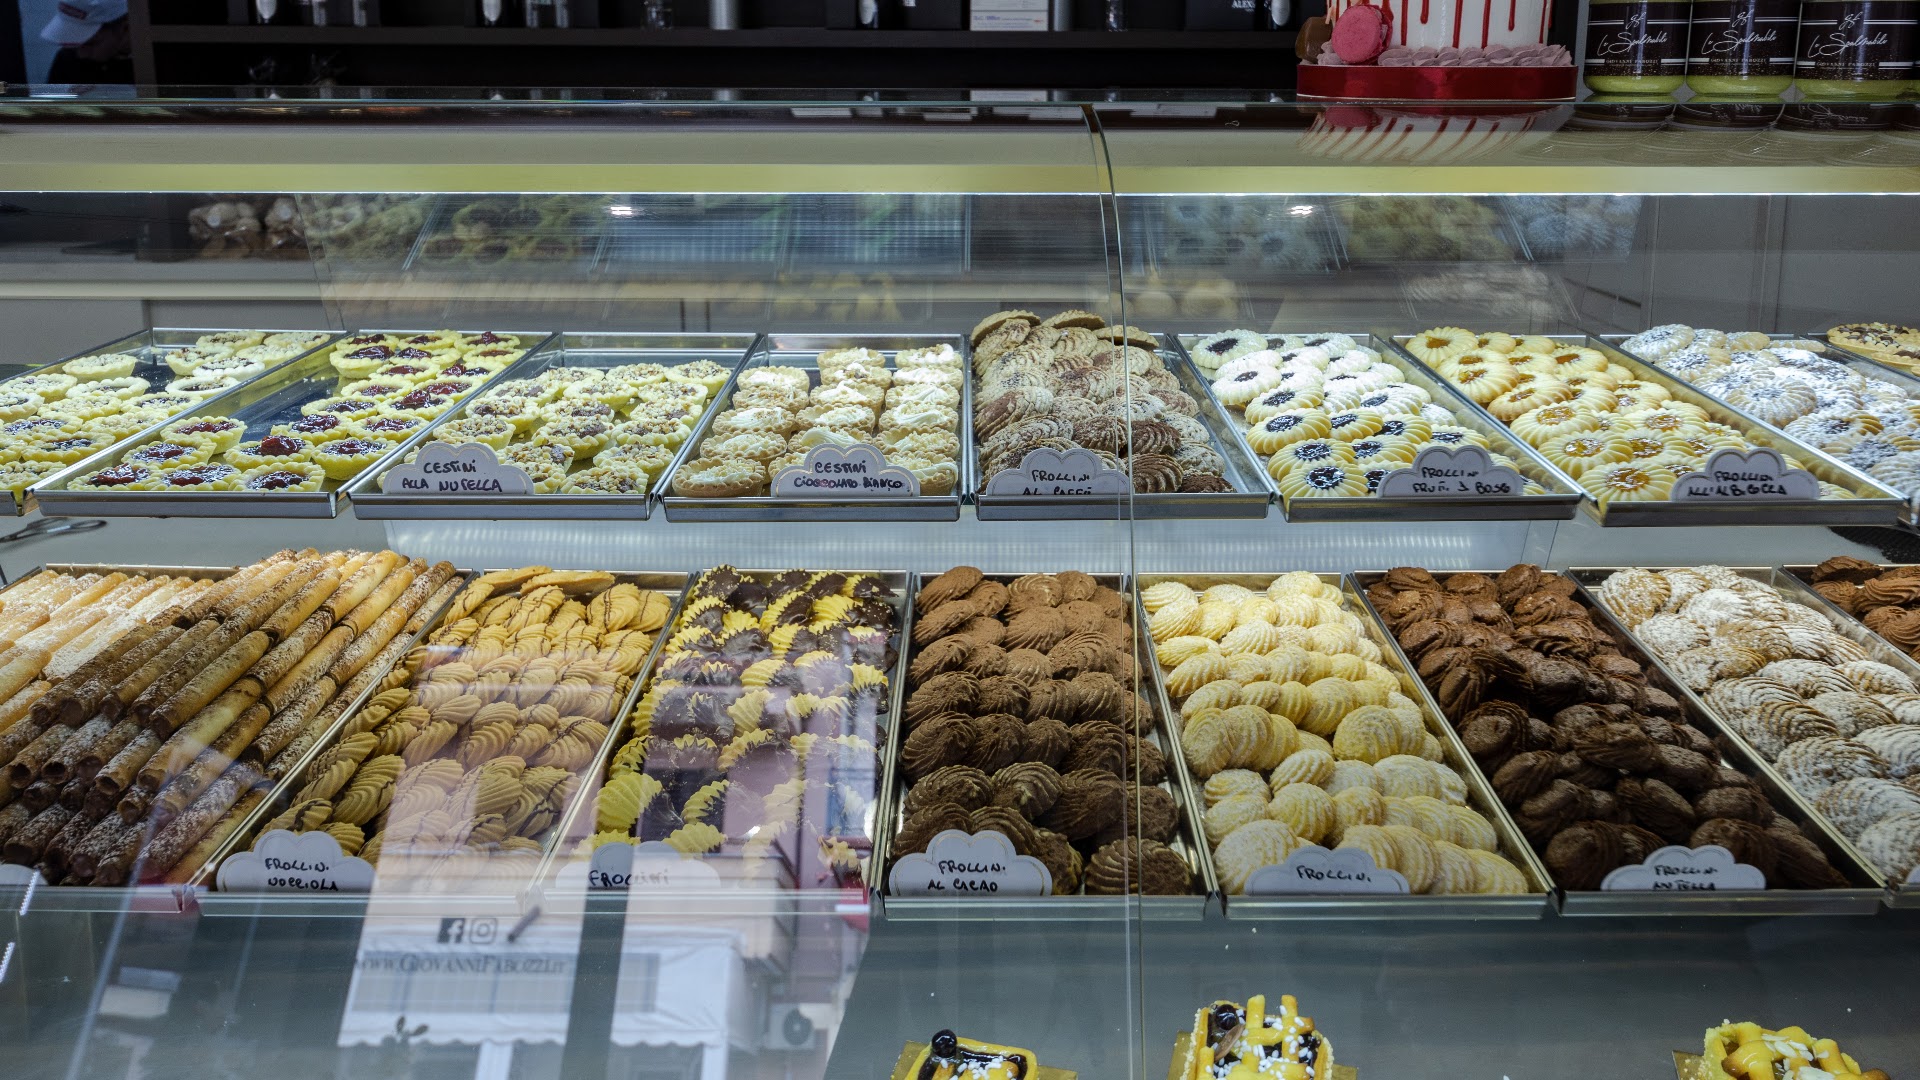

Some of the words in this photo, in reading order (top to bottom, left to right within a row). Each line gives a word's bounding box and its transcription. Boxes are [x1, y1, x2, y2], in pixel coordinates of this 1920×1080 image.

[423, 459, 477, 474] CESTINI
[814, 459, 867, 474] CESTINI
[402, 478, 429, 489] ALLA
[927, 879, 946, 890] AL
[952, 877, 999, 892] CACAO
